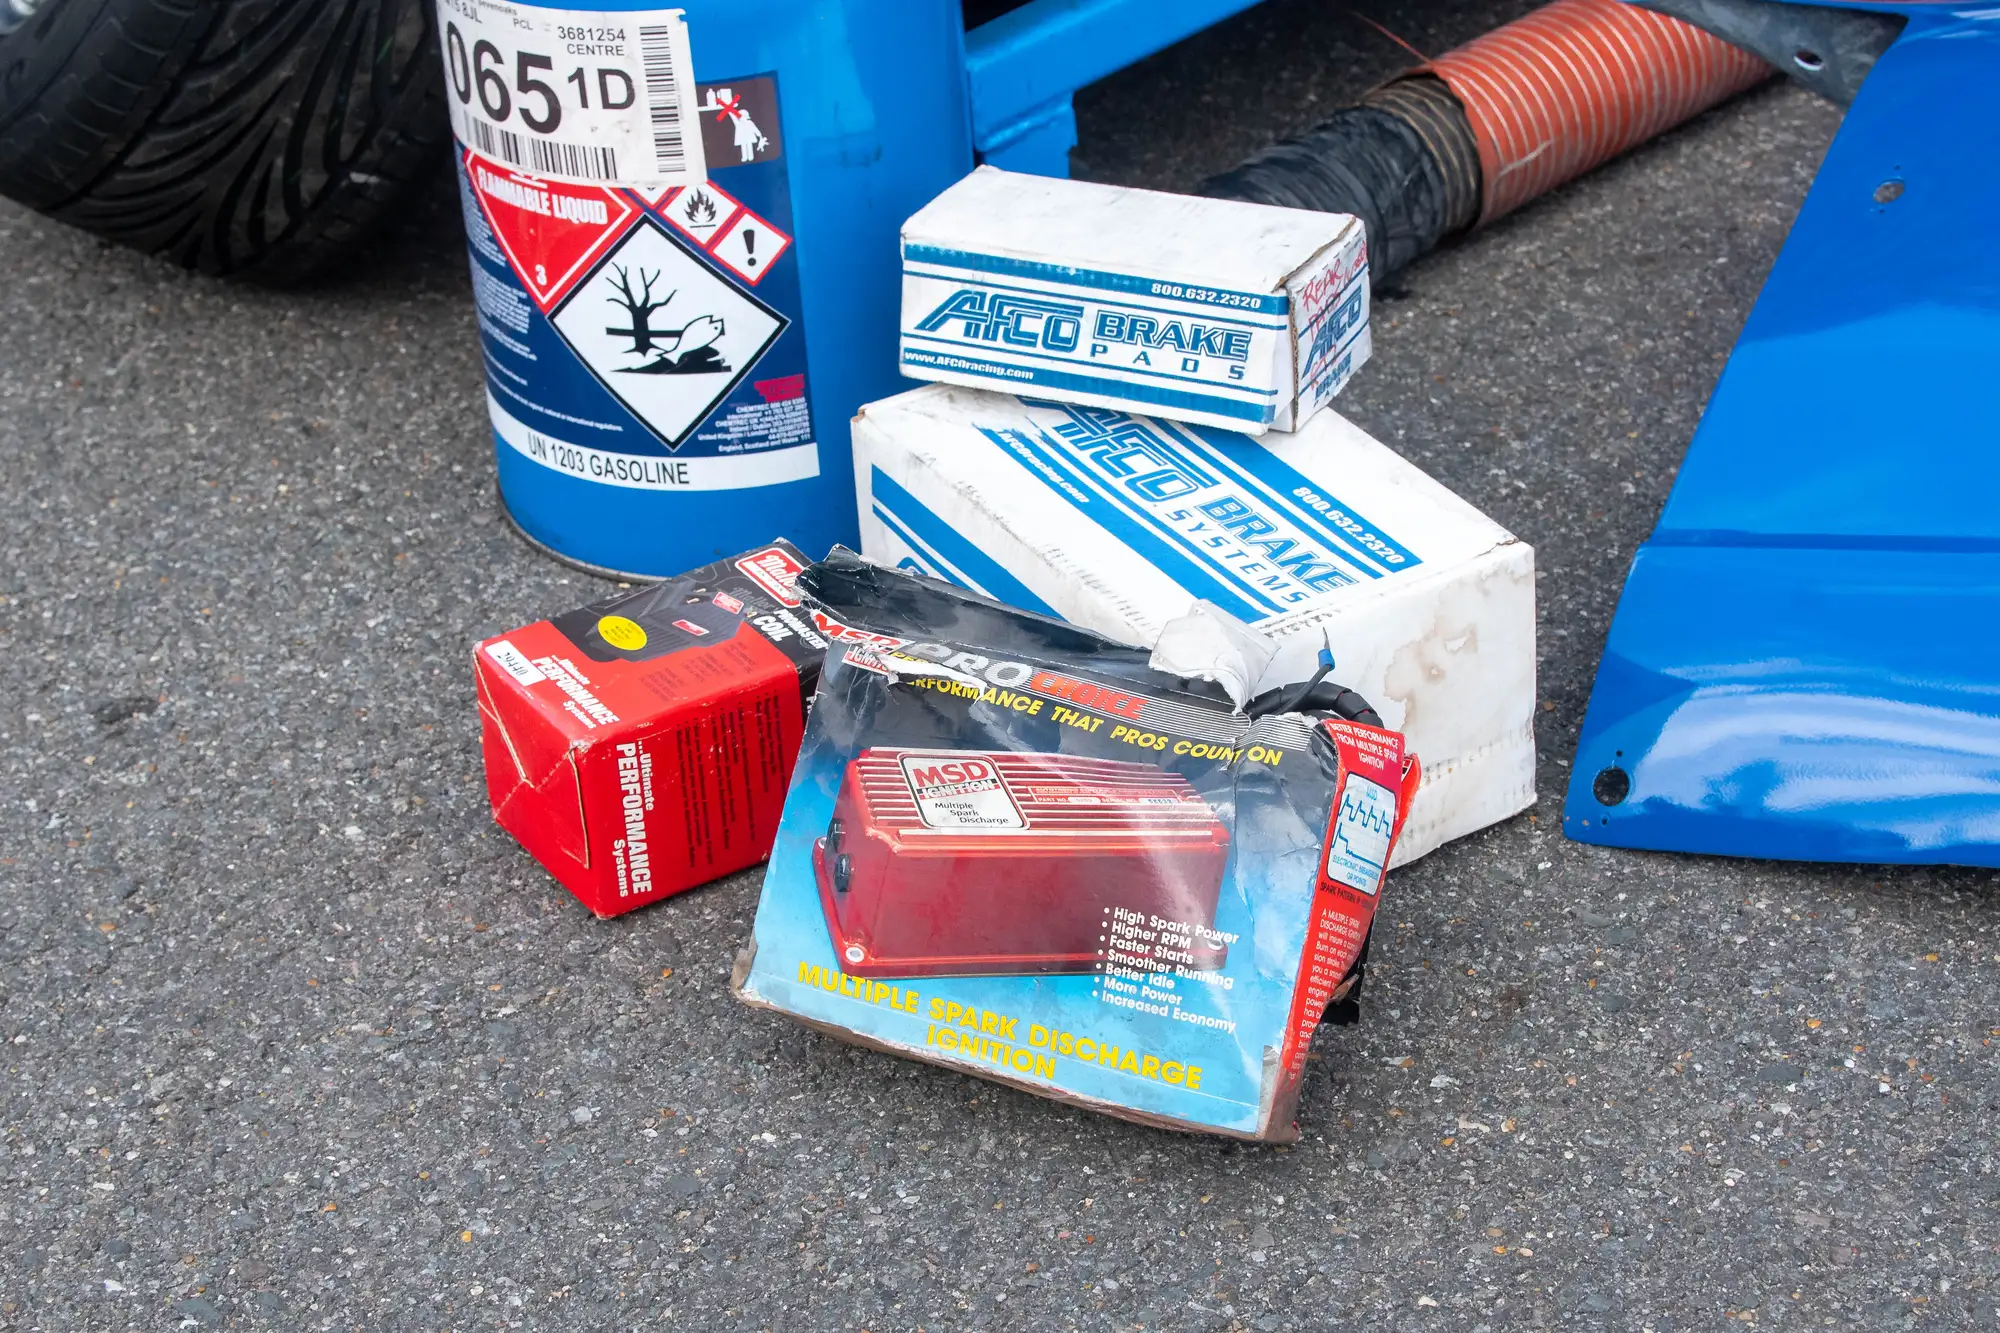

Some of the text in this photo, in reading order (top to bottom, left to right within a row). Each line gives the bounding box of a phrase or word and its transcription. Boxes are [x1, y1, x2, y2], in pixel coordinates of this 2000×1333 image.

[513, 18, 533, 30] PCL
[557, 26, 626, 41] 3681254
[566, 44, 625, 56] CENTRE
[476, 165, 552, 216] FLAMMABLE
[551, 194, 608, 225] LIQUID
[535, 264, 547, 286] 3
[1303, 258, 1343, 312] REAR
[1151, 283, 1261, 309] 800.632.2320
[914, 289, 1251, 362] AFCO BRAKE
[904, 351, 1034, 381] www.AFCOracing.com
[527, 431, 690, 485] UN 1203 GASOLINE
[1292, 487, 1406, 564] 800.632.2320
[1164, 509, 1311, 603] SYSTEMS
[1194, 493, 1360, 594] BRAKE
[753, 616, 793, 642] COIL
[774, 609, 829, 650] PROMASTER
[531, 656, 620, 725] PERFORMANCE
[907, 643, 1033, 687] PRO
[1029, 671, 1148, 720] CHOICE
[563, 700, 597, 729] Systems
[1050, 705, 1104, 732] THAT
[1110, 725, 1168, 751] PROS
[1173, 741, 1245, 764] COUNT
[1247, 746, 1283, 766] ON
[1336, 733, 1398, 764] FROM MULTIPLE SPARK
[1353, 726, 1398, 750] PERFORMANCE
[913, 762, 989, 788] MSD
[1358, 752, 1384, 771] IGNITION
[921, 779, 995, 800] IGNITION
[616, 743, 653, 894] PERFORMANCE
[935, 802, 974, 810] Multiple
[950, 809, 979, 818] Spark
[959, 817, 1010, 825] Discharge
[612, 840, 628, 897] Systems
[1113, 907, 1240, 945] High Spark Power
[1320, 918, 1348, 936] DISCHARGE
[1328, 909, 1349, 925] MULTIPLE
[1112, 920, 1192, 949] Higher RPM
[1109, 935, 1194, 965] Faster Starts
[1105, 963, 1175, 989] Better Idle
[1107, 949, 1235, 990] Smoother Running
[1104, 976, 1183, 1005] More Power
[797, 961, 1203, 1090] MULTIPLE SPARK DISCHARGE
[1102, 990, 1237, 1034] Increased Economy
[927, 1024, 1056, 1080] IGNITION
